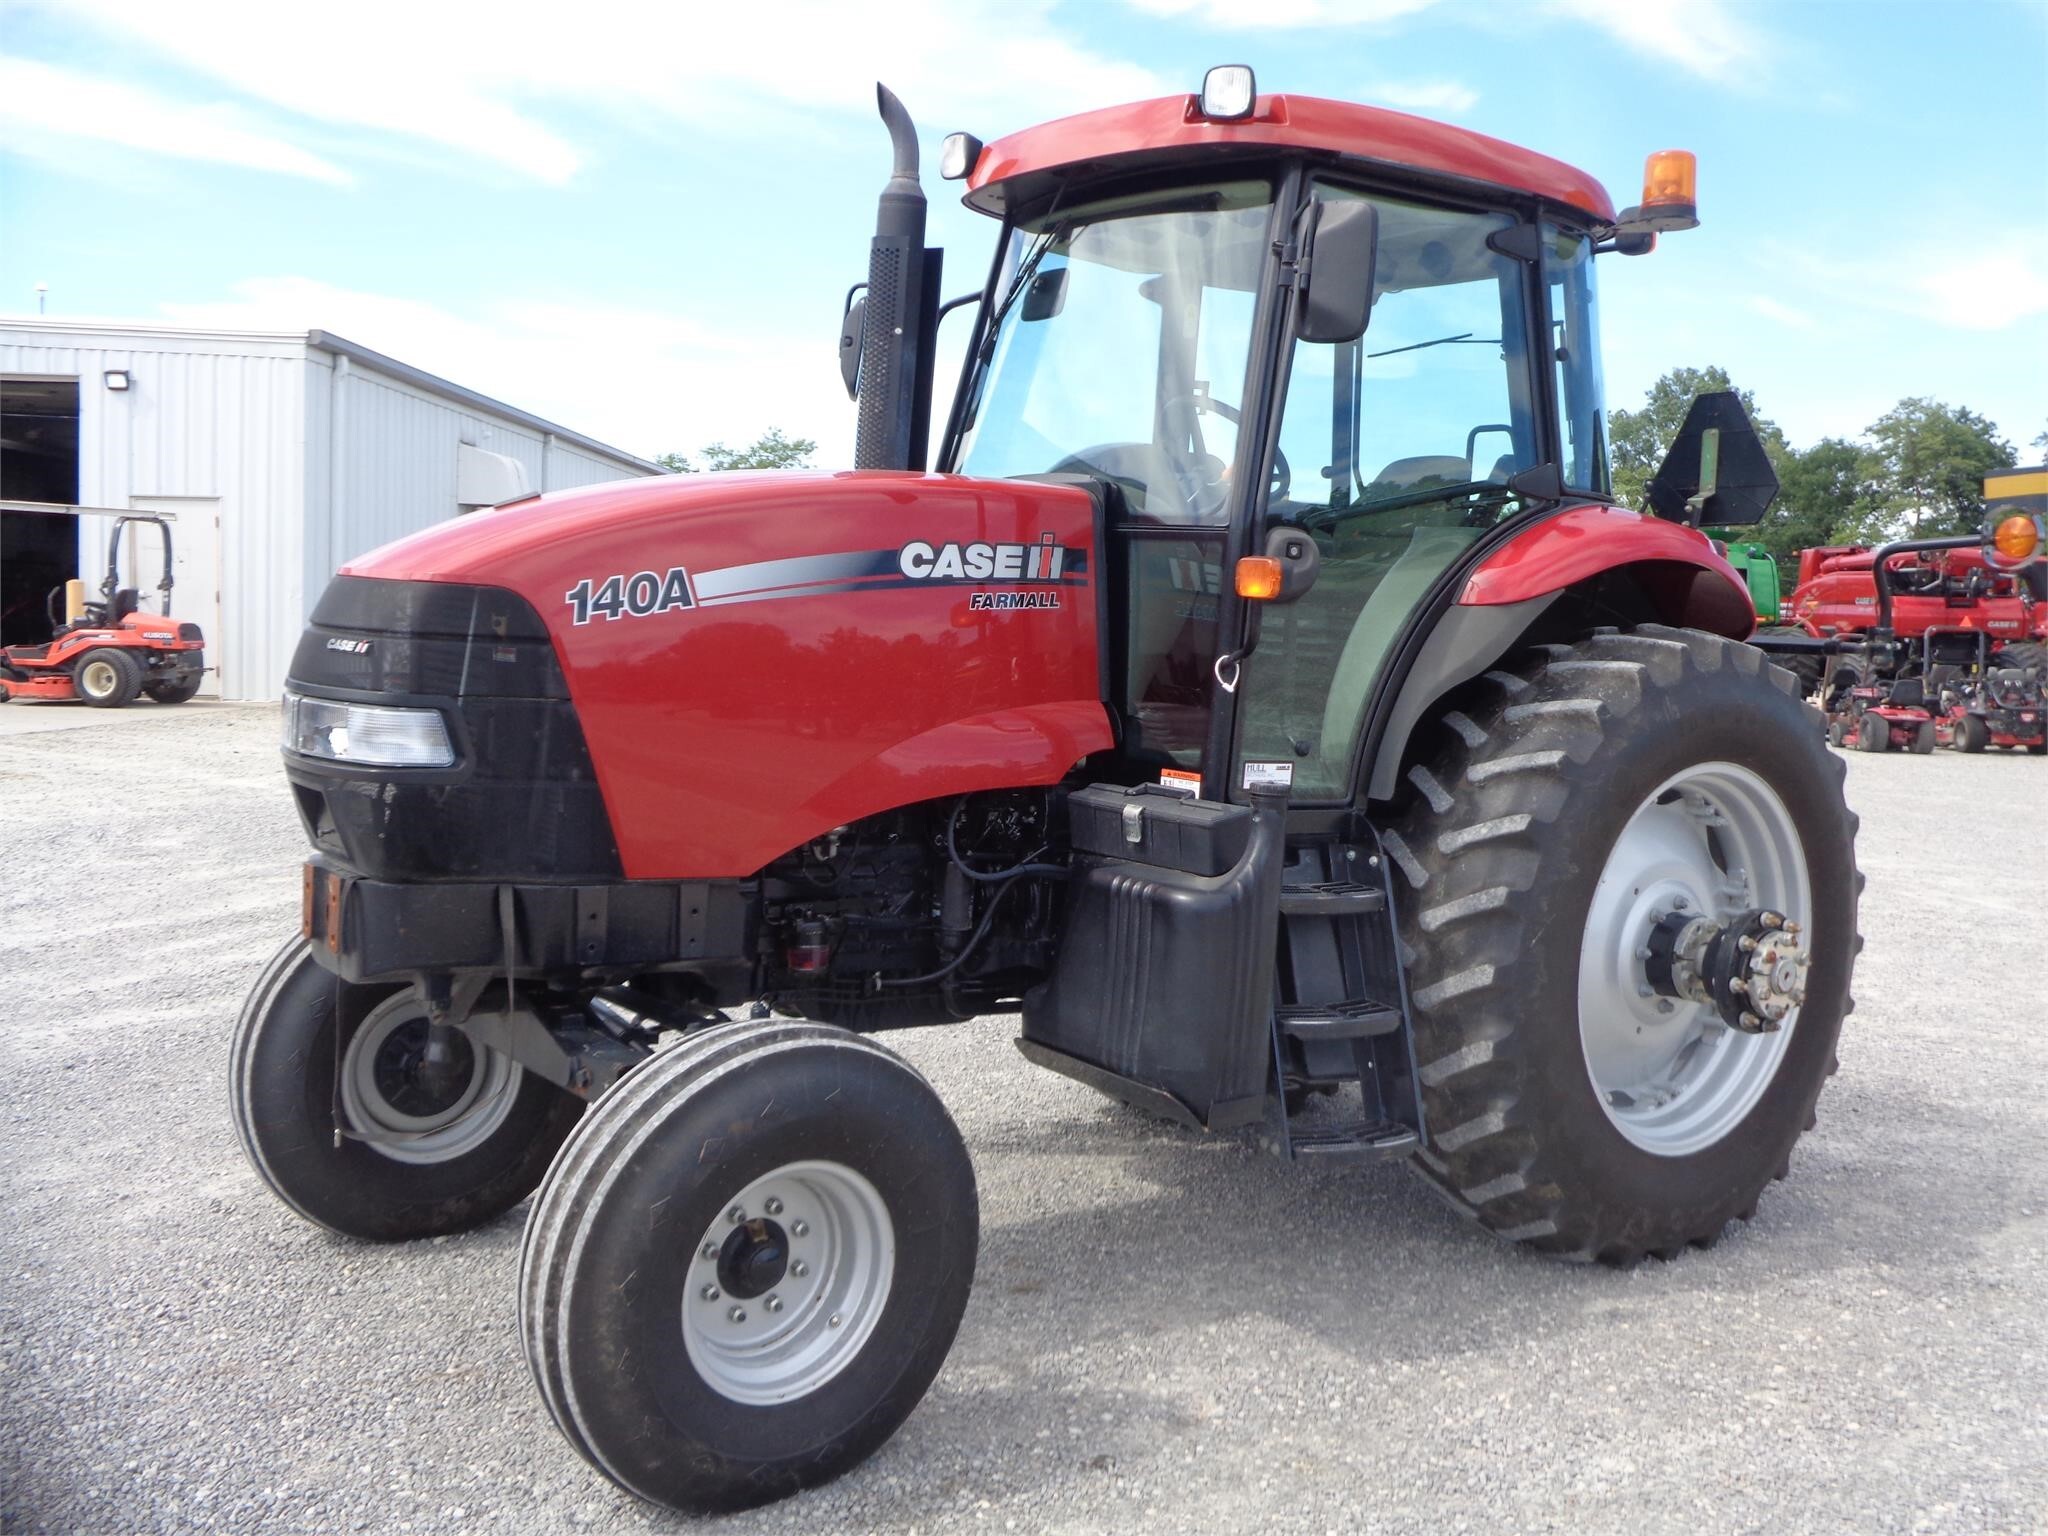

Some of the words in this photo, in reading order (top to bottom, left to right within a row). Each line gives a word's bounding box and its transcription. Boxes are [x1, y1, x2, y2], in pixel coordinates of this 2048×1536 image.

[899, 541, 1024, 579] CASE
[565, 566, 697, 626] 140A
[969, 592, 1060, 610] FARMALL
[327, 638, 358, 651] CASE
